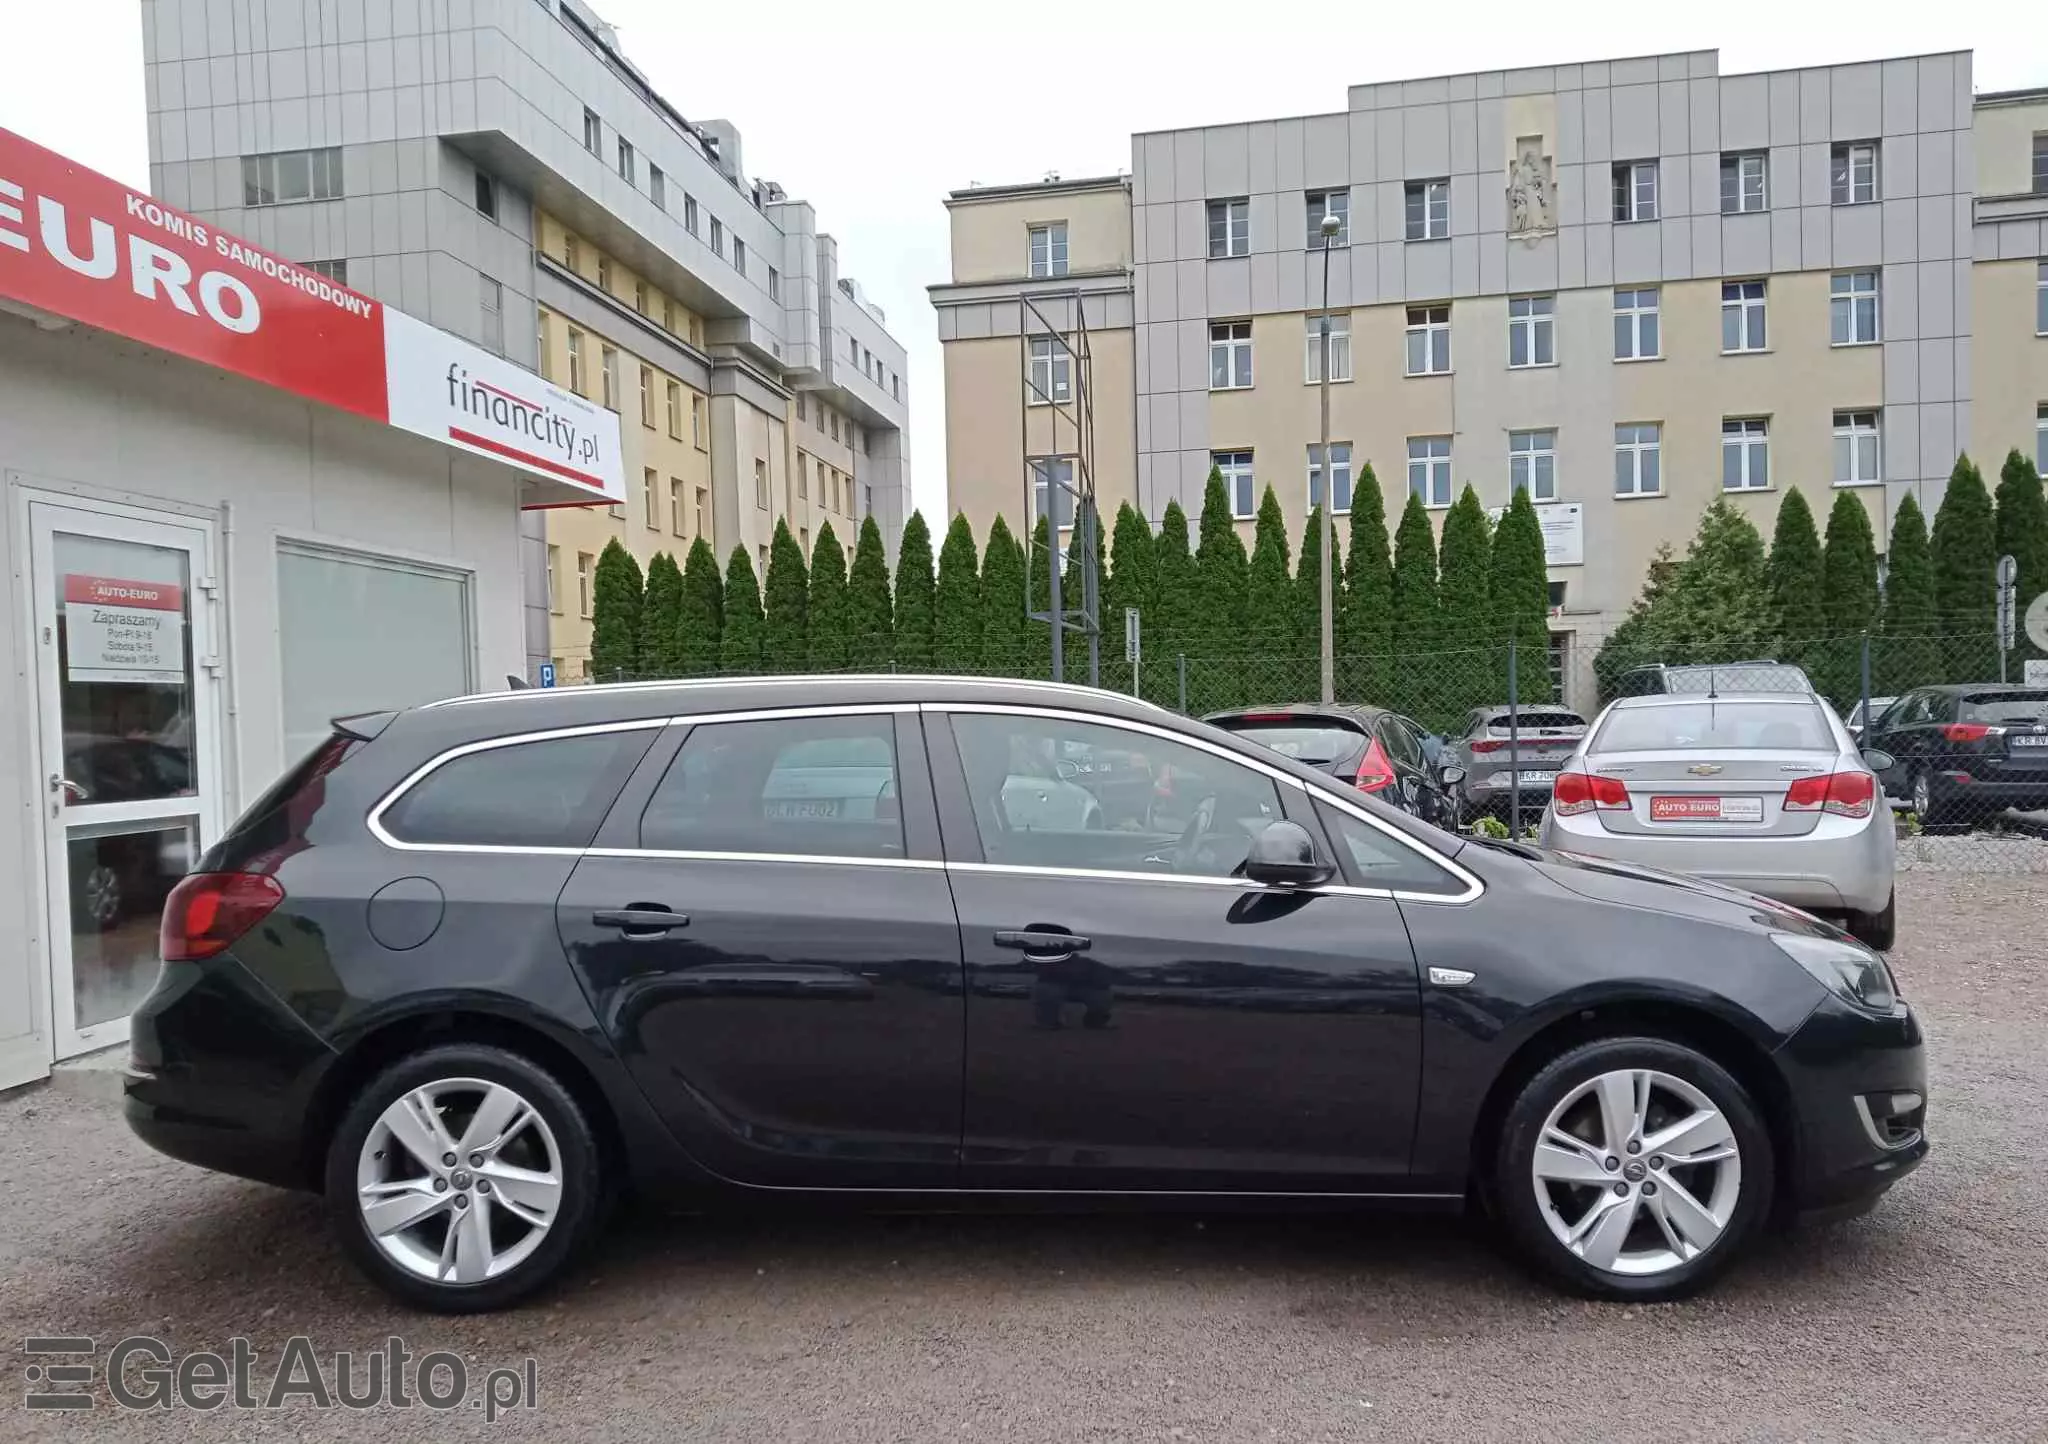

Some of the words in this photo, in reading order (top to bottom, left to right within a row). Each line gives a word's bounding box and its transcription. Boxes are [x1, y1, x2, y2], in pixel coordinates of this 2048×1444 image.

[126, 193, 209, 247] KOMIS
[215, 234, 372, 319] SAMOCHODOWY
[446, 362, 600, 465] financity.pl
[97, 586, 159, 601] AUTO-EURO
[92, 608, 161, 630] Zapraszamy
[1658, 803, 1687, 812] AUTO
[1690, 803, 1719, 812] EURO
